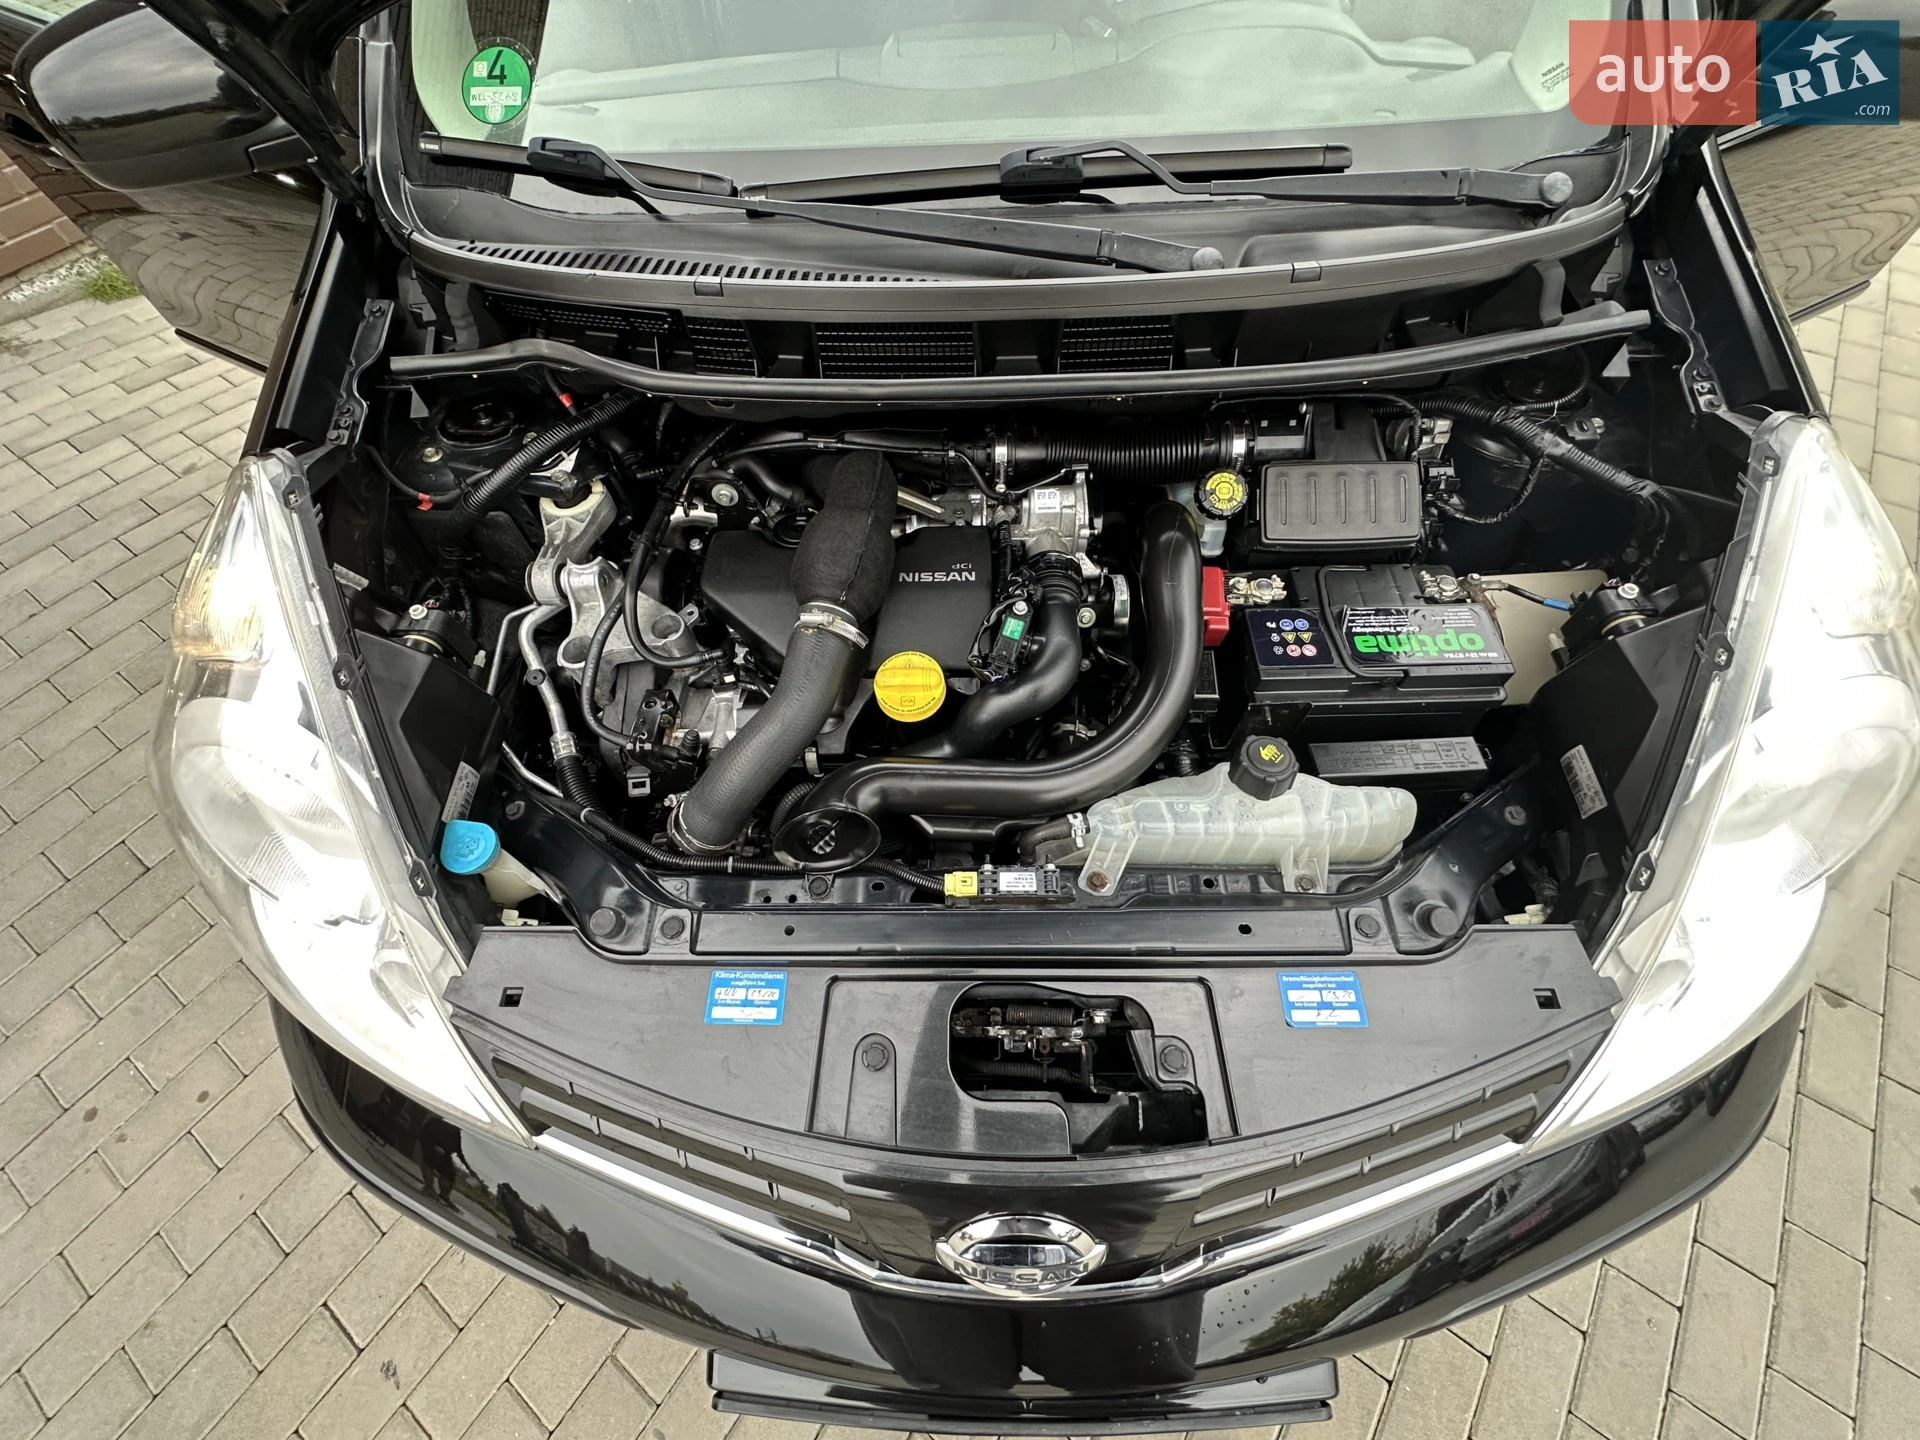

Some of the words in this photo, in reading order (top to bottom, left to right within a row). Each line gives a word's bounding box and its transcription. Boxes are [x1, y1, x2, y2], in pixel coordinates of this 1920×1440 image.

[487, 49, 507, 85] 4
[898, 571, 976, 582] NISSAN
[1354, 629, 1485, 656] optima
[715, 971, 784, 980] Klima-Kundendienst
[953, 1260, 1090, 1284] NISSAN
